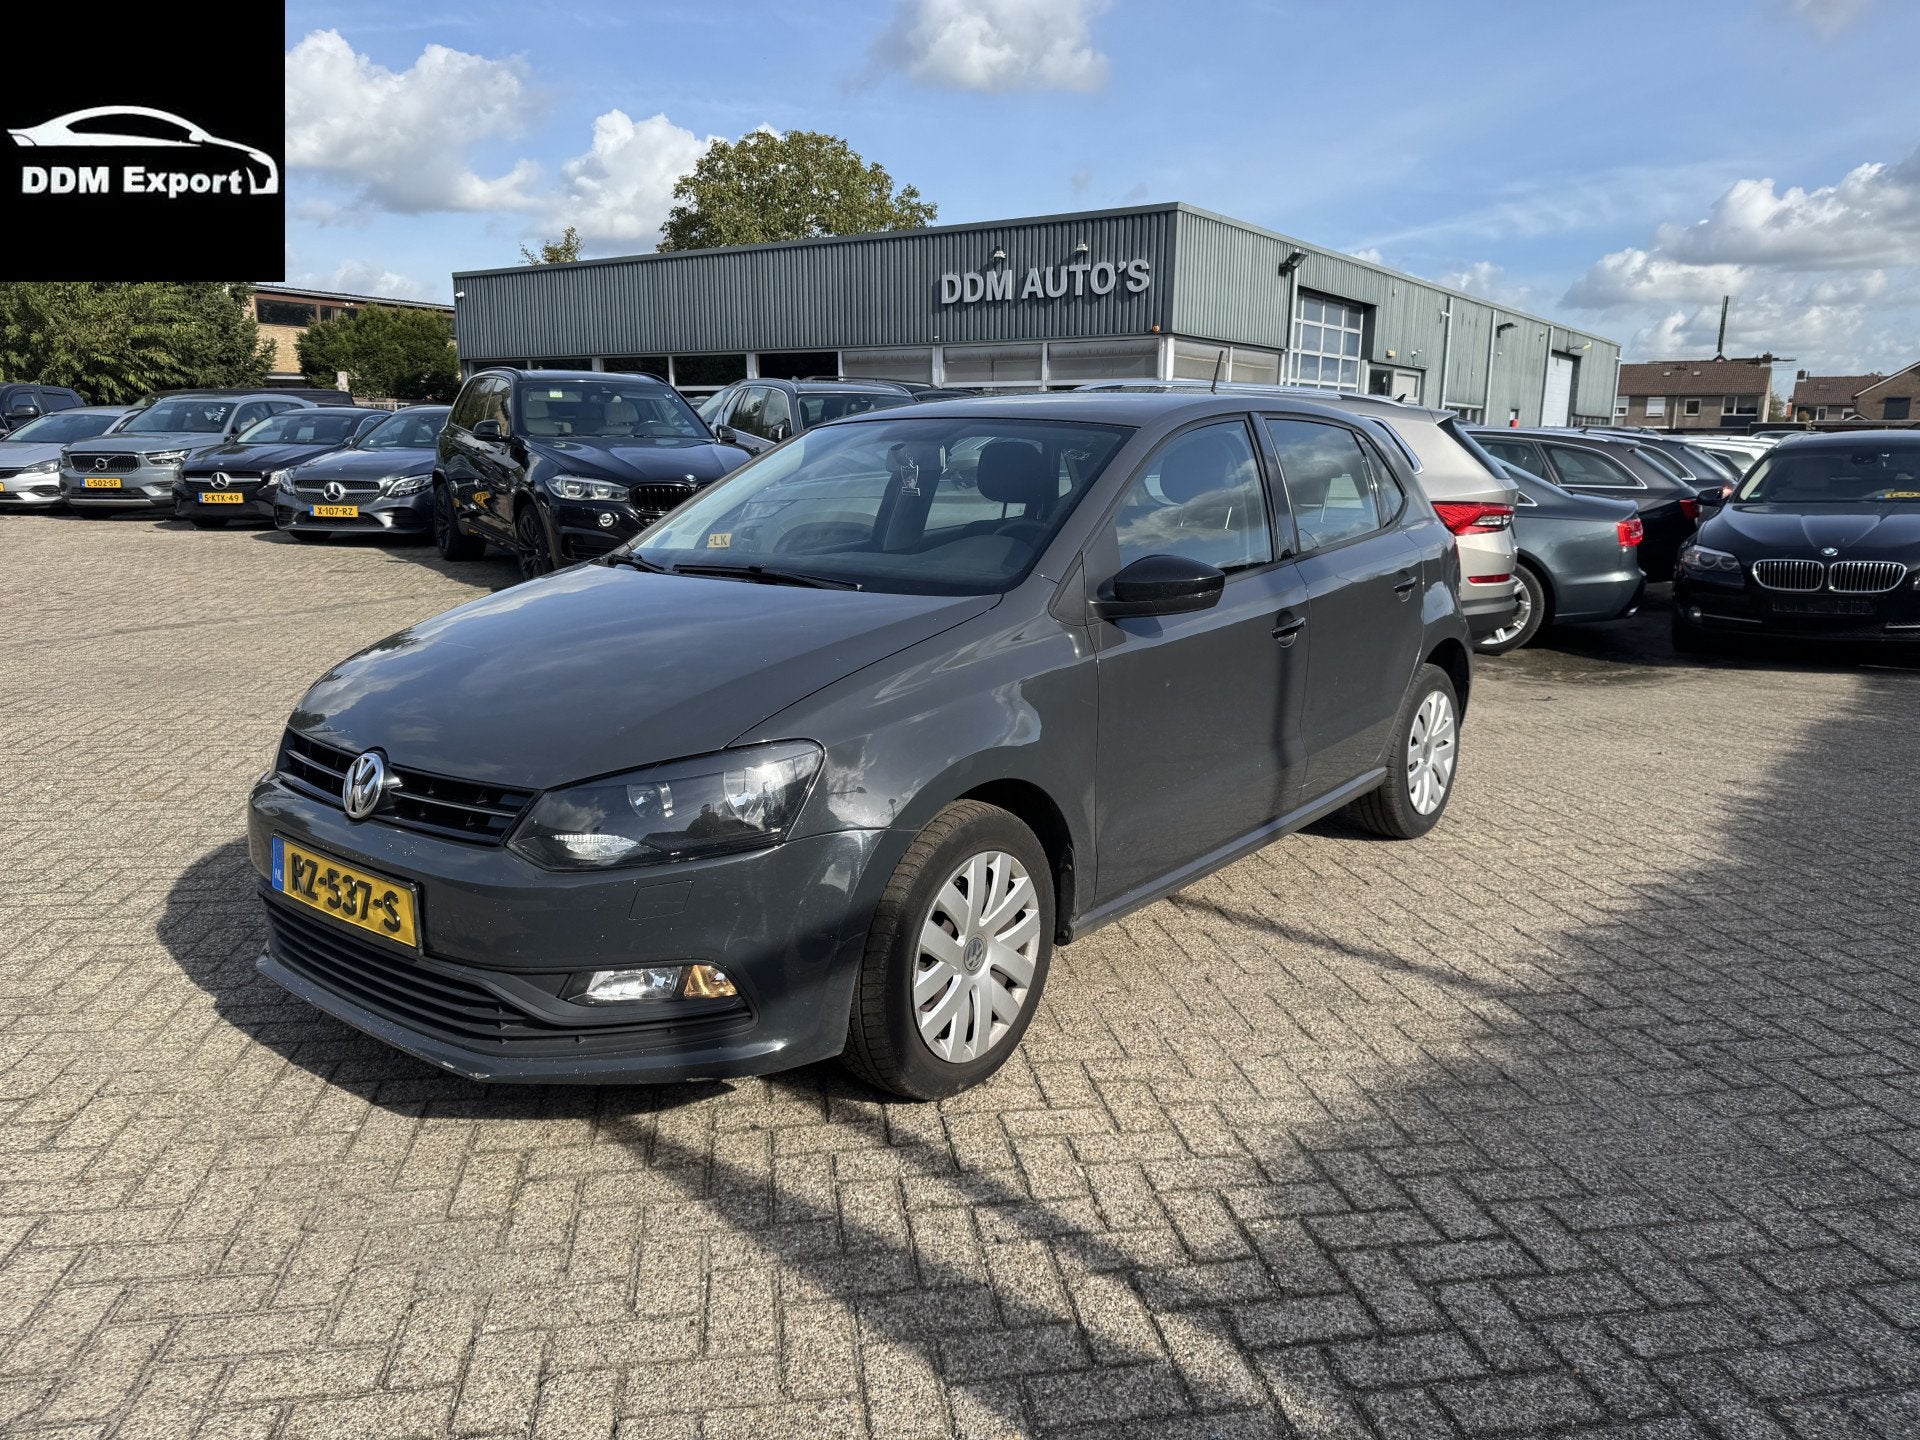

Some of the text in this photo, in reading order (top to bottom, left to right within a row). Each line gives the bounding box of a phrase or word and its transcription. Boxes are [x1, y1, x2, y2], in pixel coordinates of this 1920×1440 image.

[941, 258, 1150, 304] DDM AUTO'S
[86, 479, 118, 487] L-502-SF
[317, 506, 353, 516] X-107-RZ
[291, 852, 400, 932] RZ-537-S
